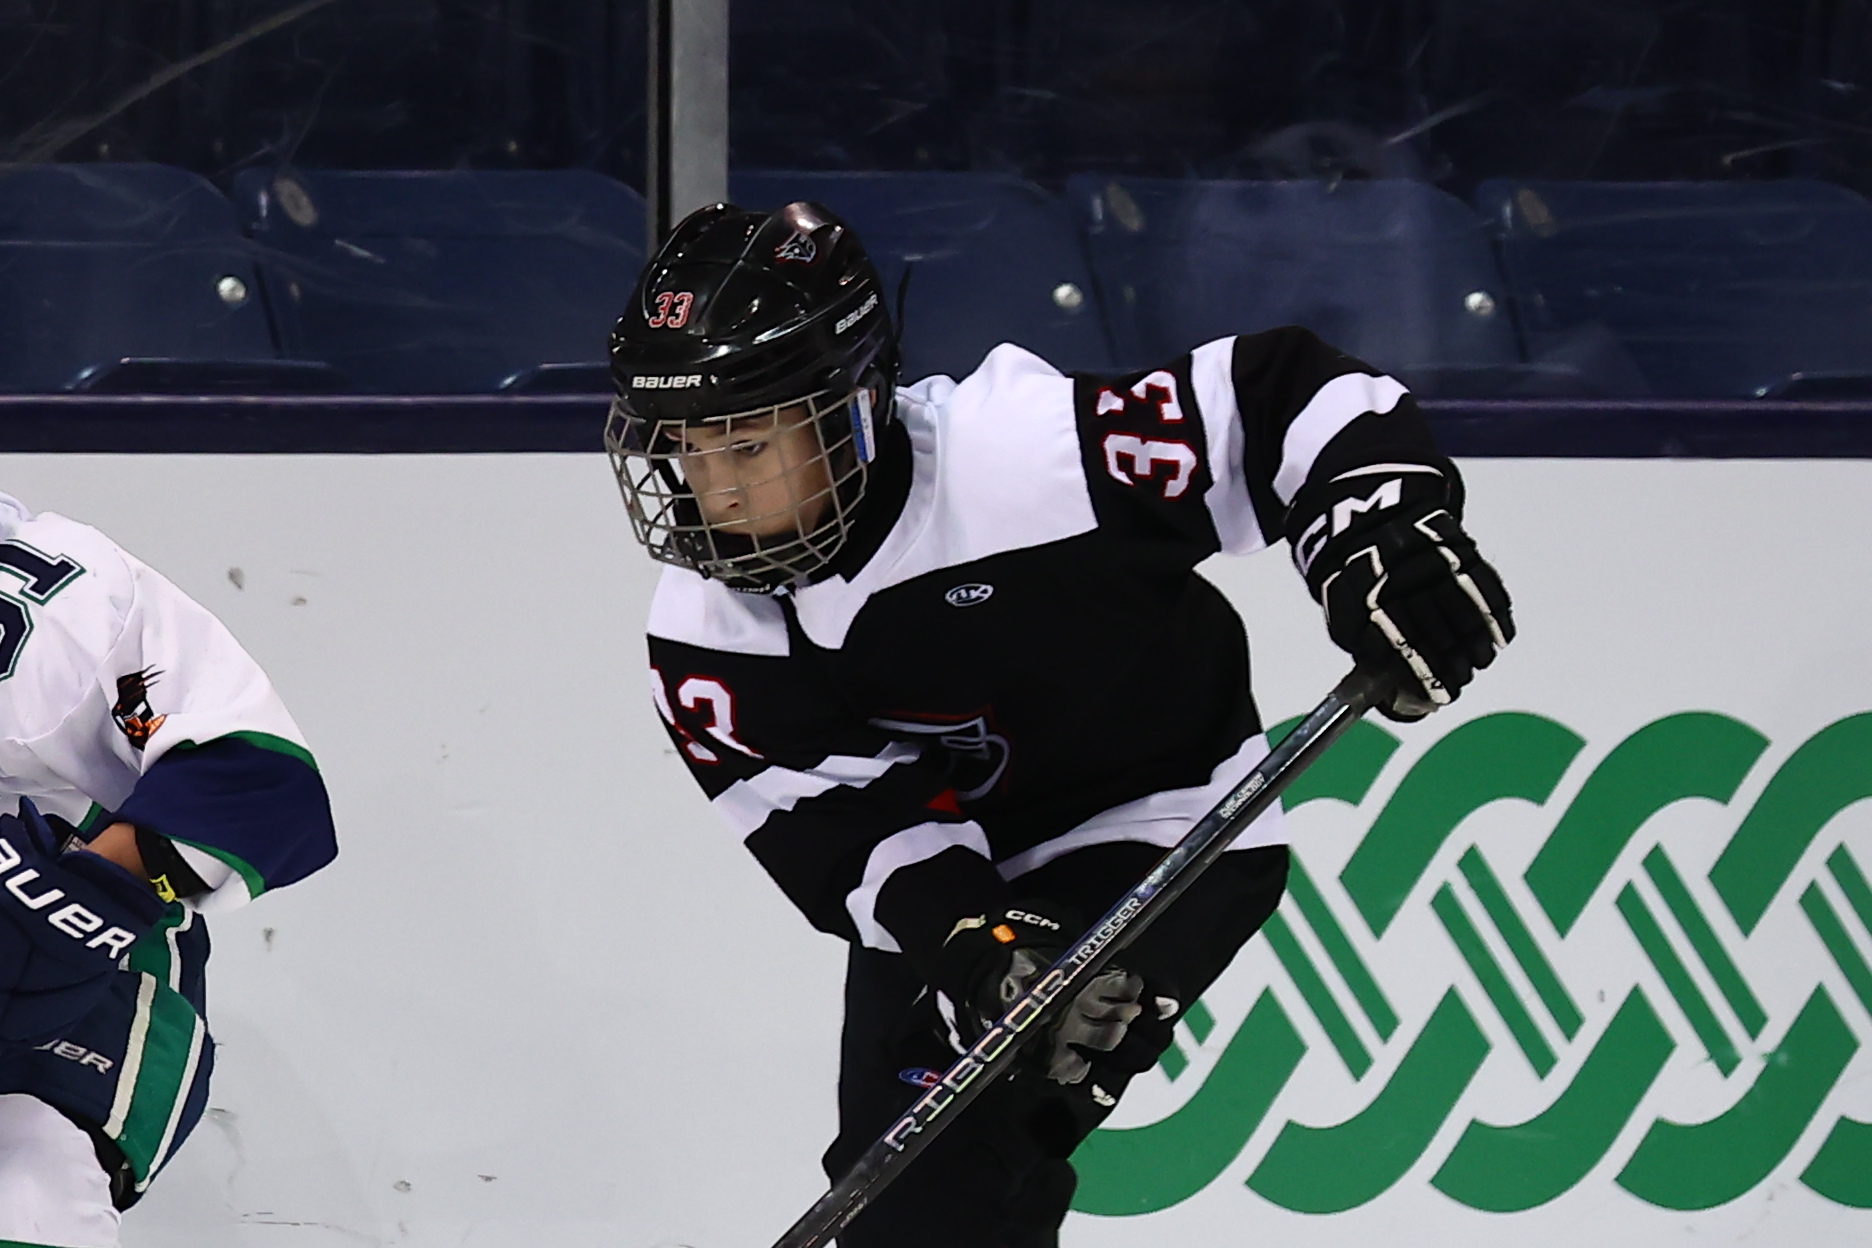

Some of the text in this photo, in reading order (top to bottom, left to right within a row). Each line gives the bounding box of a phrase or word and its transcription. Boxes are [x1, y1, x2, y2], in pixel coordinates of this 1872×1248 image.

[649, 292, 694, 328] 33
[834, 294, 879, 335] BAUER
[632, 374, 702, 389] BAUER
[1005, 909, 1060, 931] CCM
[1068, 897, 1142, 967] TRIGGER
[884, 968, 1065, 1151] RIBCOR
